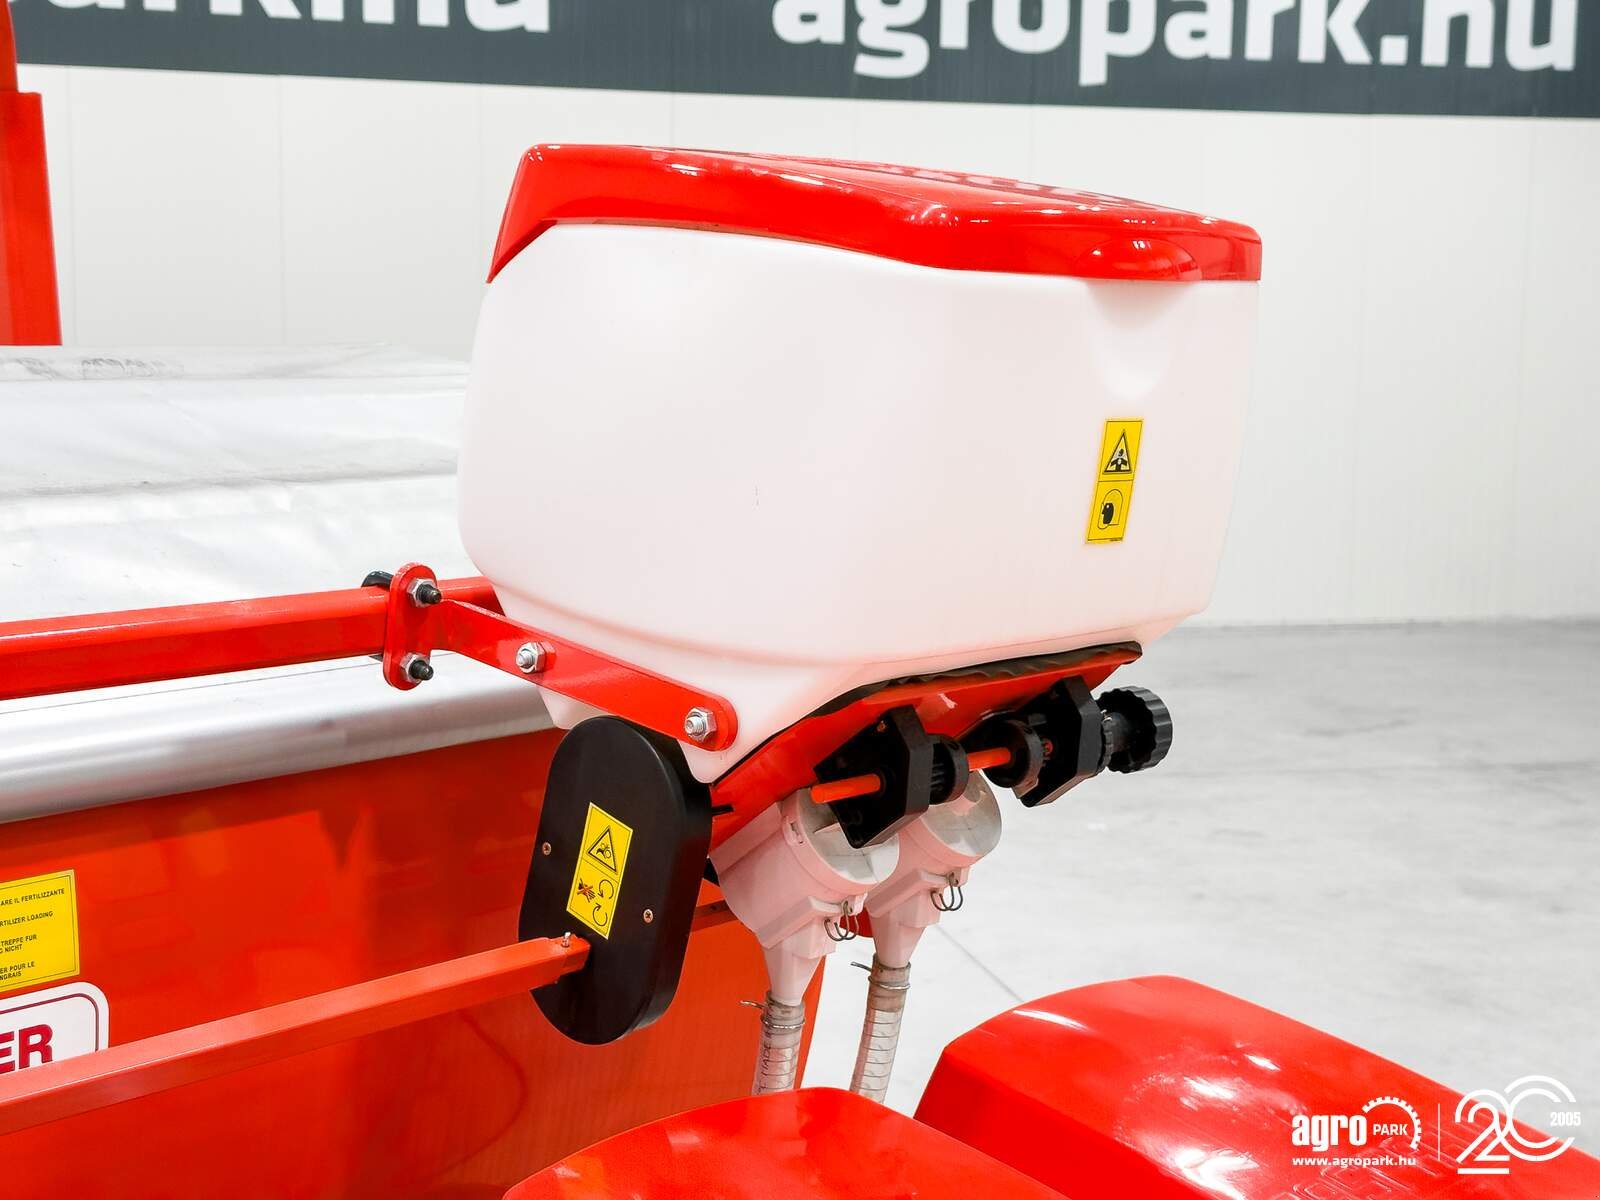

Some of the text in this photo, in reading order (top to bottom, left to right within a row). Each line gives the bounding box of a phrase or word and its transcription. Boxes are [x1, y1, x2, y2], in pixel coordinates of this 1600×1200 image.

[21, 888, 65, 902] FERTILIZZANTE
[27, 911, 54, 922] LOADING
[1, 937, 24, 947] TREPPE
[5, 944, 22, 953] NICHT
[10, 962, 26, 971] POUR
